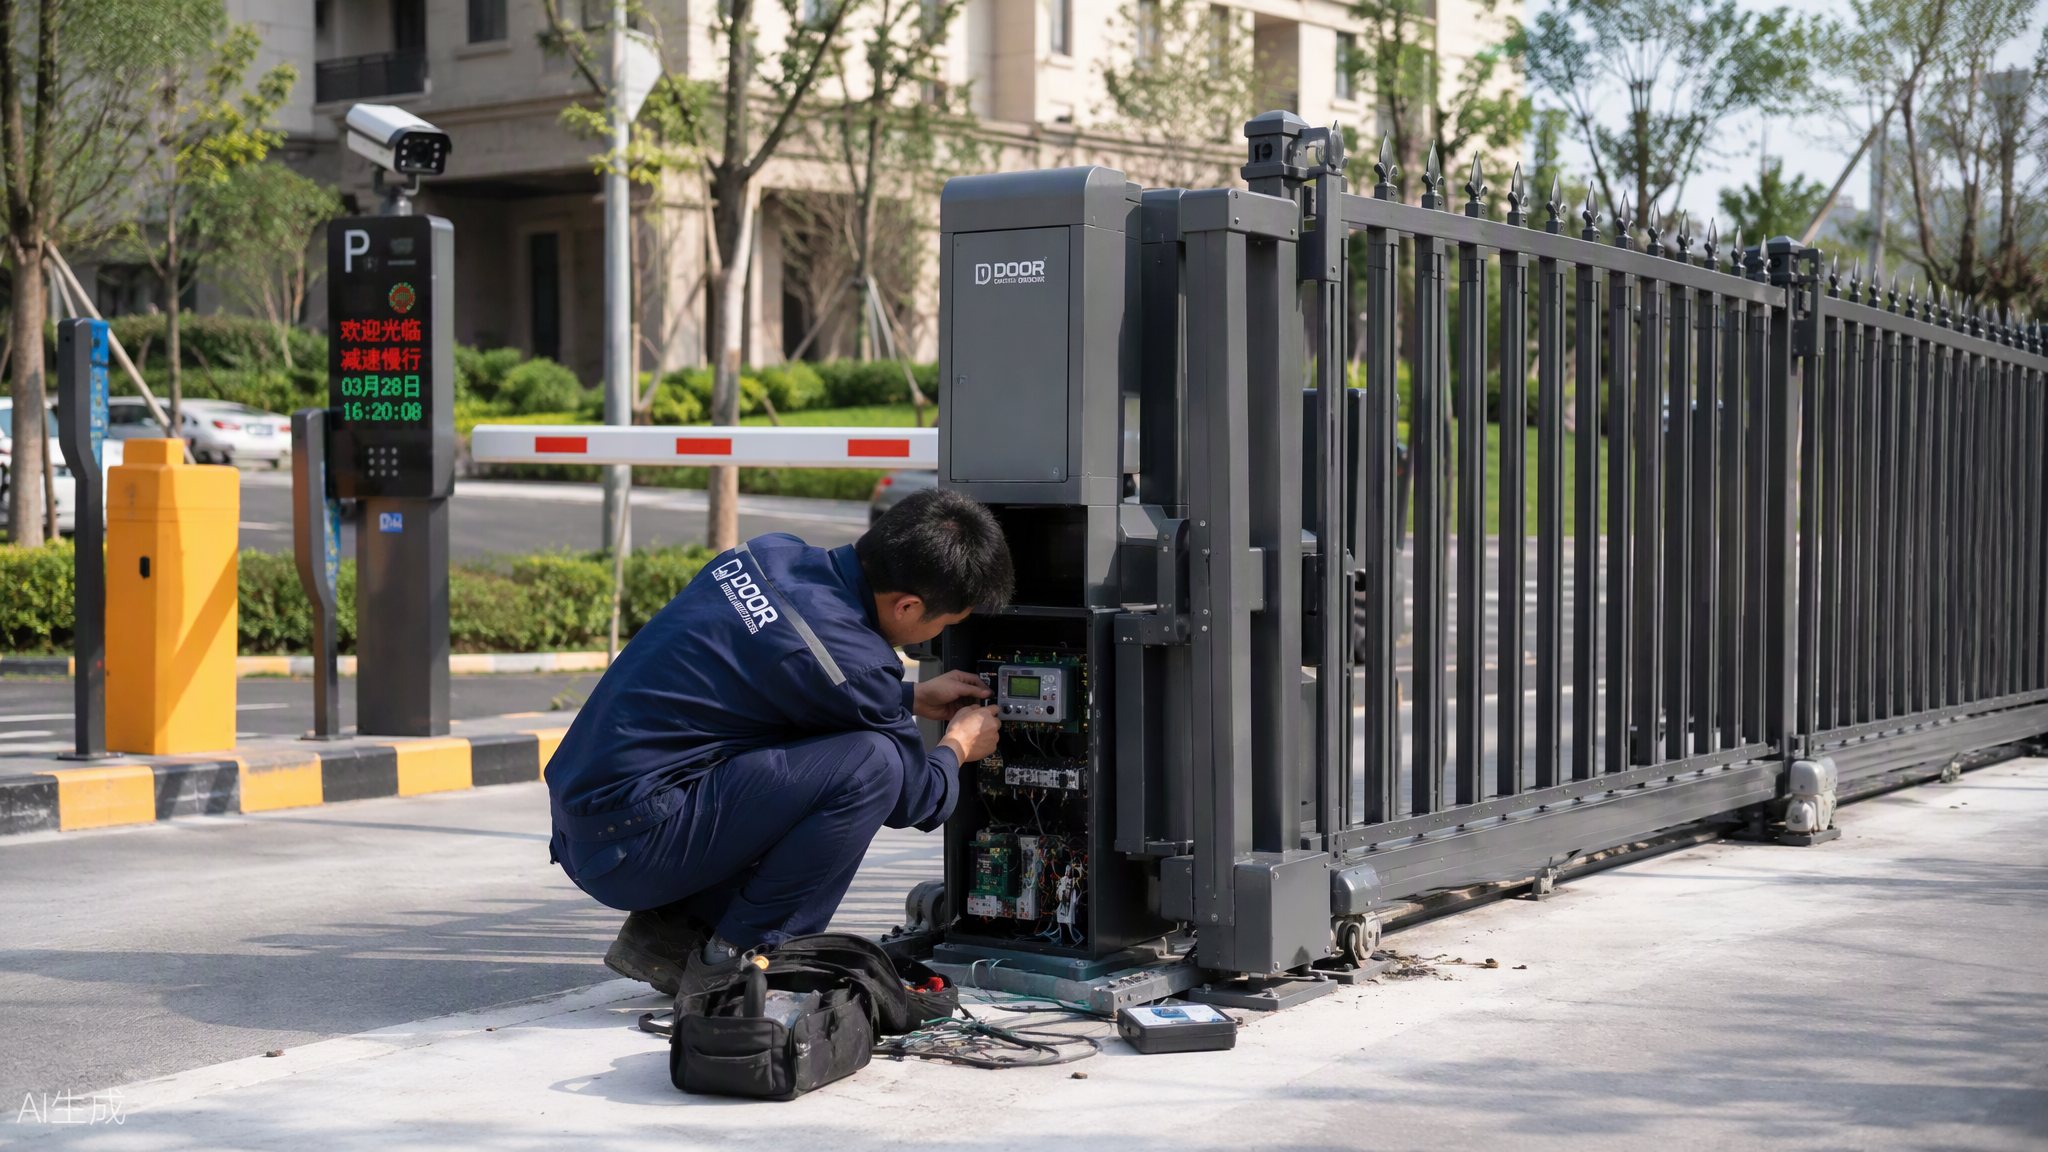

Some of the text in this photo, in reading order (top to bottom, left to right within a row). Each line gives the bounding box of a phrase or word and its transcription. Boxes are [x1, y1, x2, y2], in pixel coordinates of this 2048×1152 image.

[344, 229, 371, 273] P
[994, 260, 1045, 277] DOOR
[340, 318, 421, 342] 欢迎光临
[340, 347, 421, 371] 减速慢行
[341, 375, 419, 398] 03月28日
[343, 402, 422, 421] 16:20:08
[730, 572, 779, 629] DOOR
